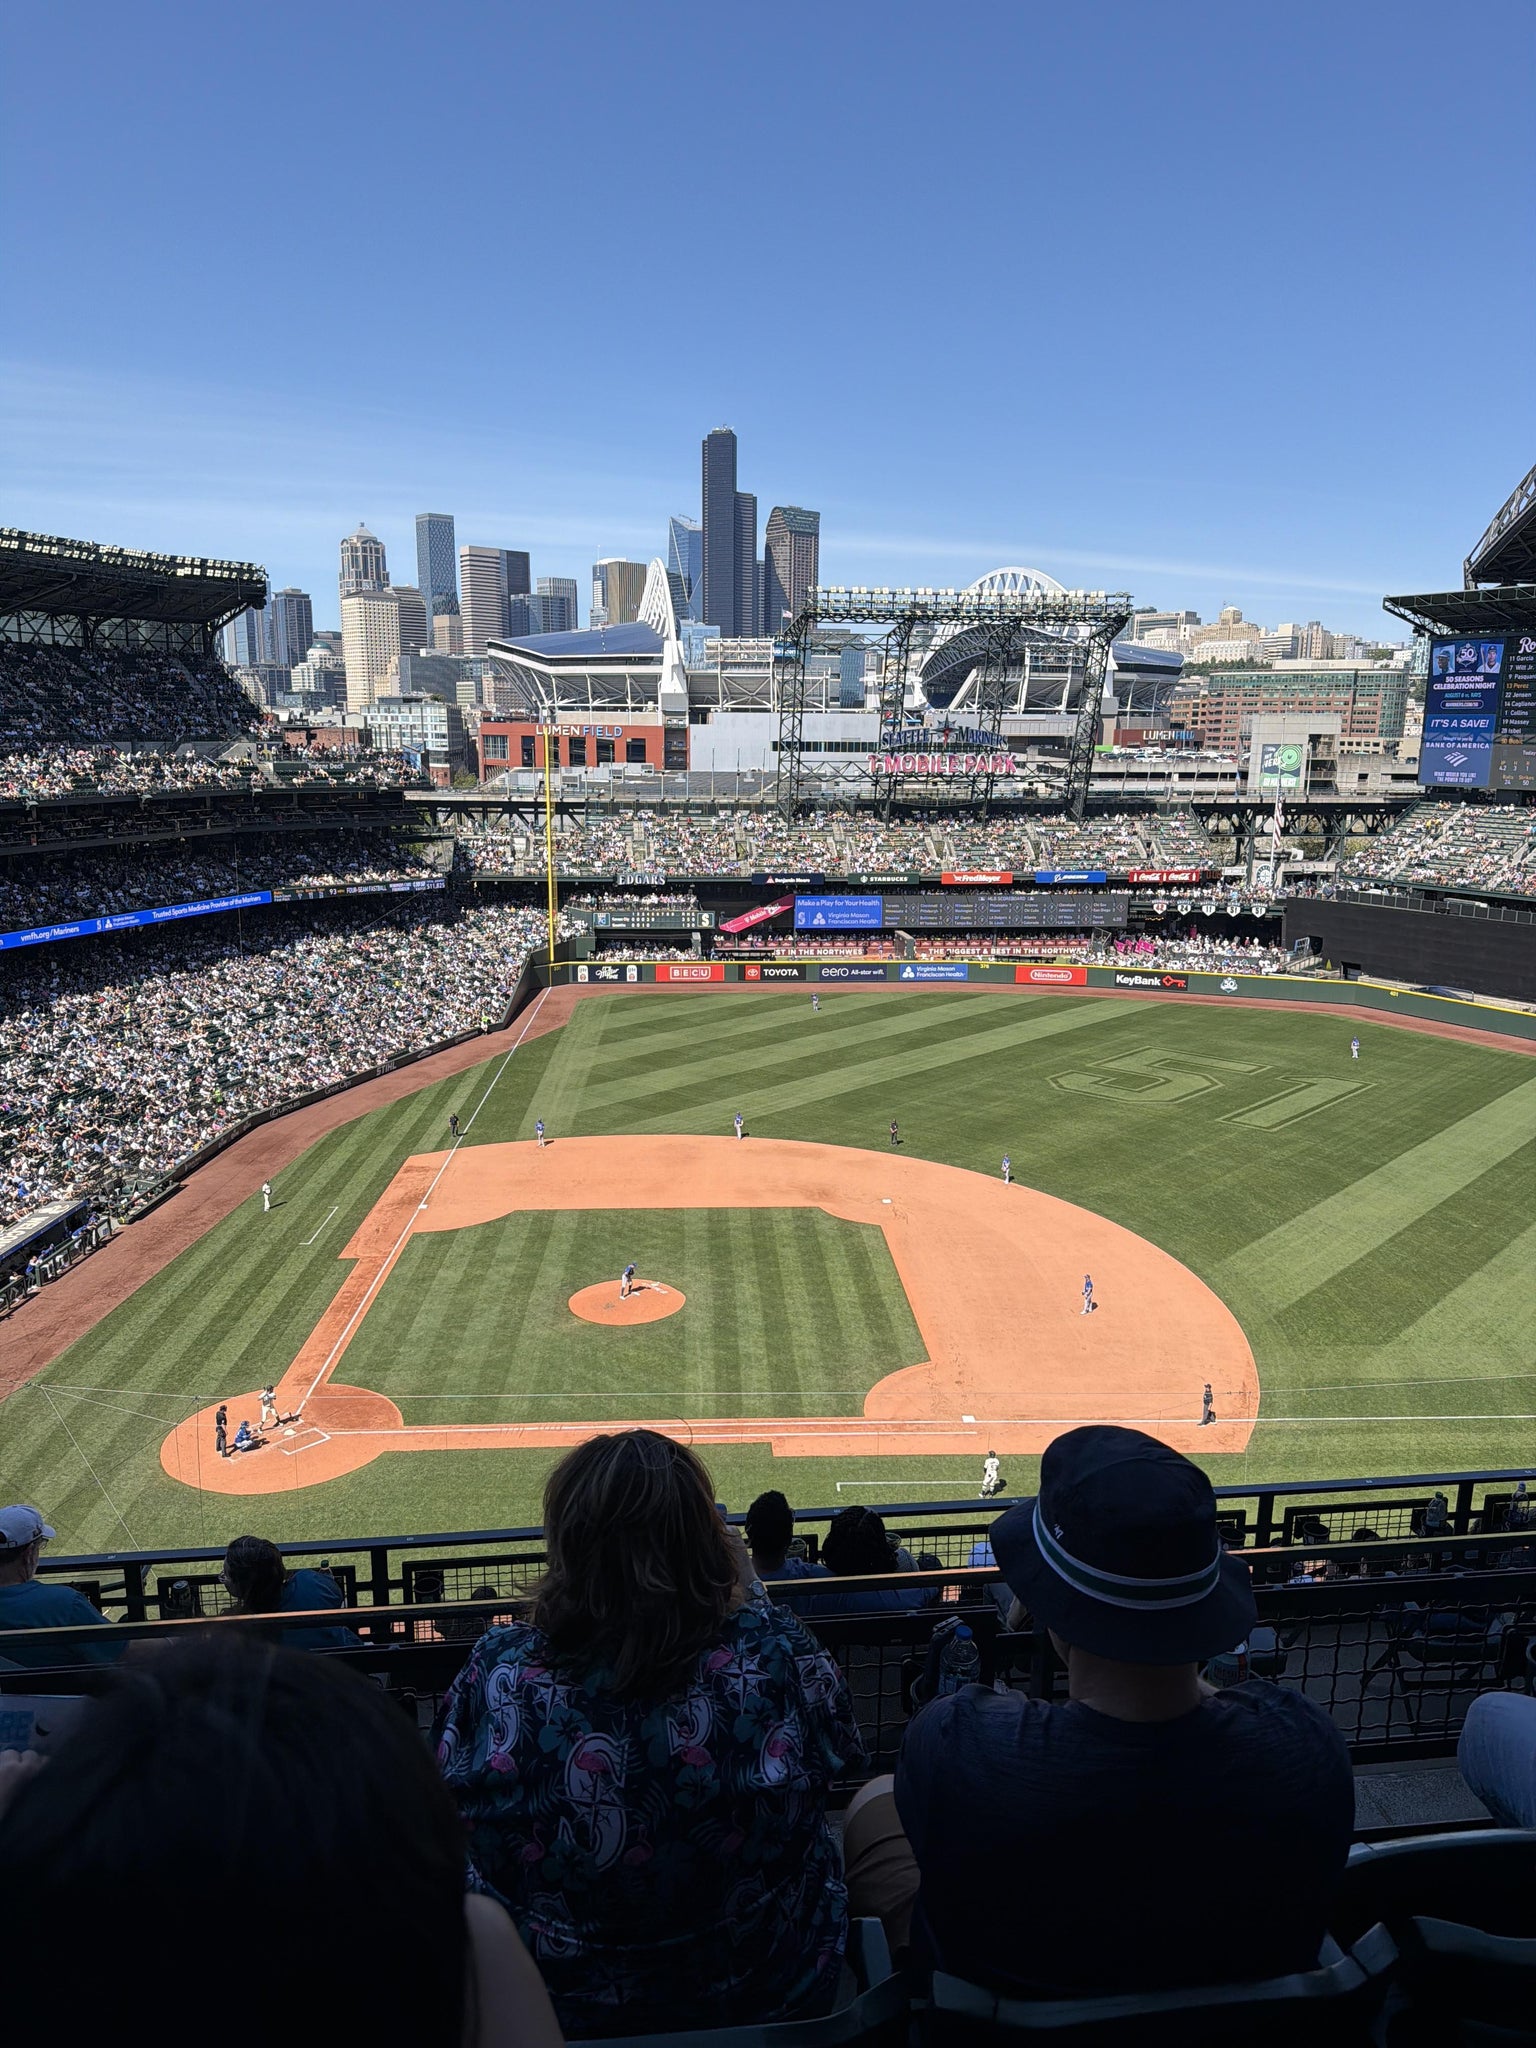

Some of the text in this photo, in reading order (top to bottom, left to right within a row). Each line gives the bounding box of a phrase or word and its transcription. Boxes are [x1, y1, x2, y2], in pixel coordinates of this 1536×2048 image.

[1431, 719, 1490, 728] IT'S A SAVE!
[536, 725, 623, 737] LUMEN FIELD
[1143, 730, 1175, 740] LUMEN
[880, 726, 1009, 751] SEATTLE MARINERS
[867, 754, 1018, 775] T-MOBILE PARK
[152, 910, 172, 919] Trusted
[172, 908, 188, 916] Sports
[188, 904, 210, 913] Medicine
[210, 901, 229, 910] Provider
[242, 896, 262, 904] Mariners
[1180, 904, 1188, 912] 24
[1205, 905, 1213, 913] 11
[1229, 906, 1238, 914] 51
[1255, 906, 1263, 914] 51
[701, 913, 710, 927] S
[21, 926, 80, 942] vmfh.org/Mariners
[673, 969, 708, 977] BECU
[763, 968, 799, 976] TOYOTA
[821, 967, 849, 977] eero
[1034, 971, 1069, 979] Nintendo
[1116, 974, 1161, 987] KeyBank
[376, 1061, 397, 1076] STIHL
[1045, 1046, 1379, 1133] 51
[279, 1101, 301, 1113] LEXUS
